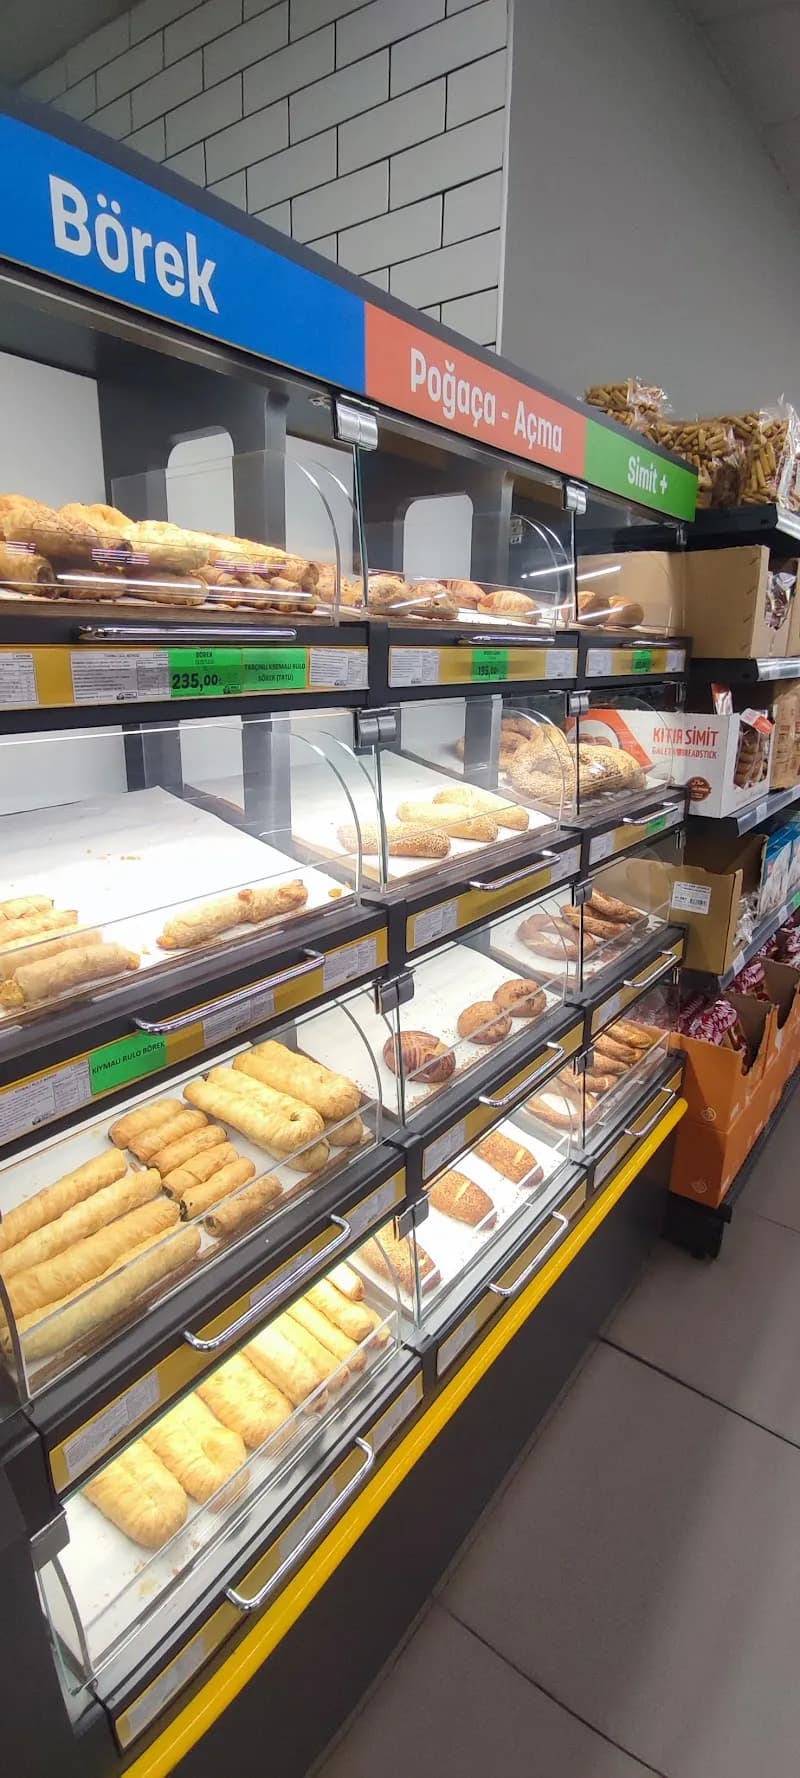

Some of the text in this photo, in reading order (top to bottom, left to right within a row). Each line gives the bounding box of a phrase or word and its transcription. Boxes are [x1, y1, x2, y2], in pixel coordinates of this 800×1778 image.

[49, 174, 218, 315] Börek
[410, 347, 497, 428] Poğaça
[514, 401, 563, 454] Açma
[627, 456, 658, 494] Simit
[653, 726, 719, 747] KITIR SİMİT
[122, 1050, 141, 1062] RULO
[142, 1040, 166, 1055] BÖREK
